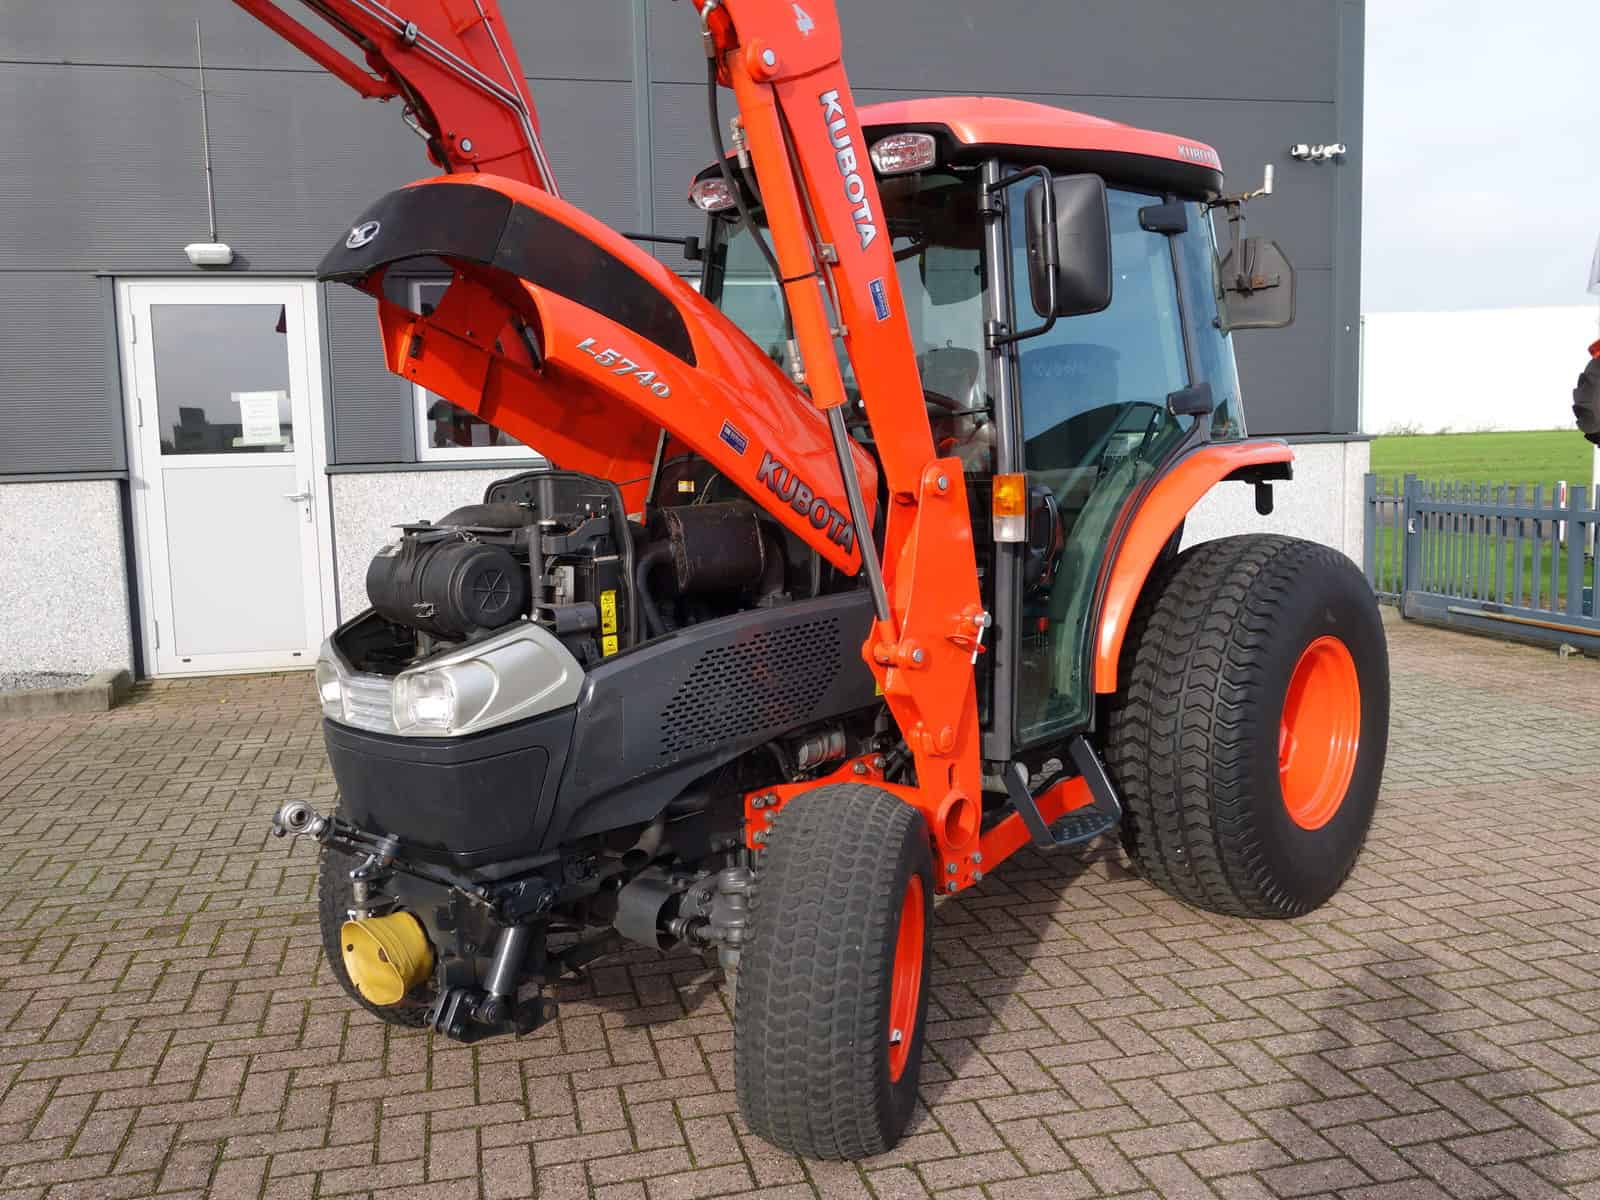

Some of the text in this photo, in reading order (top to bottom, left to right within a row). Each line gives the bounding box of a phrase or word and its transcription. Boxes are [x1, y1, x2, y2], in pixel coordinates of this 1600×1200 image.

[819, 89, 877, 250] KUBOTA
[576, 337, 671, 398] L5740
[757, 453, 855, 548] KUBOTA
